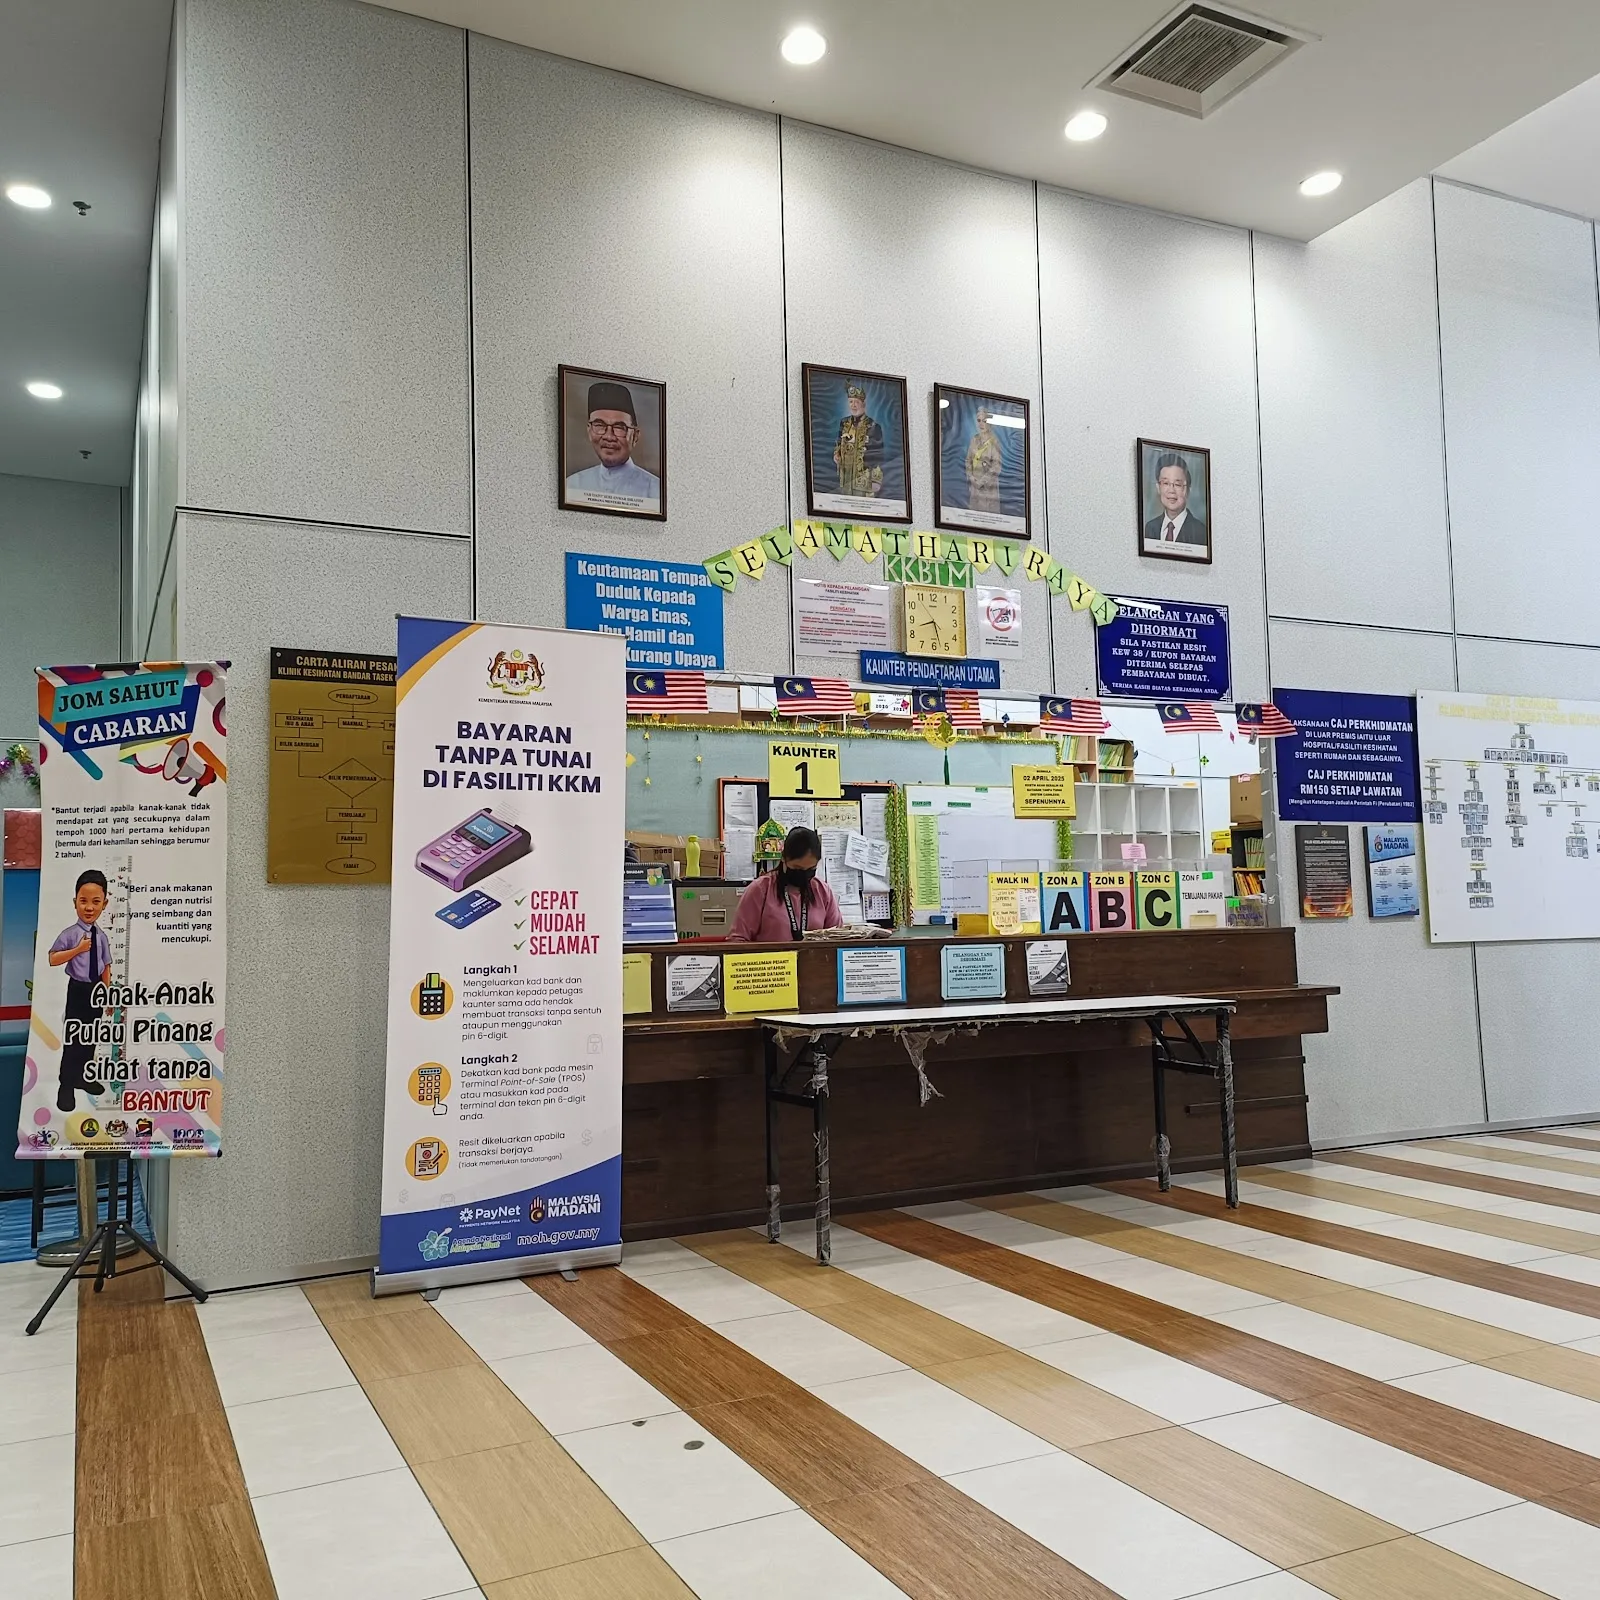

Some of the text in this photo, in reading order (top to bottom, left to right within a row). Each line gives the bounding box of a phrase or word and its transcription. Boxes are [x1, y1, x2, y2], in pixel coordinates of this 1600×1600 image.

[577, 560, 659, 582] Keutamaan
[714, 522, 1108, 623] SELAMAT HARI RAYA
[596, 582, 696, 605] Duduk Kepada
[601, 603, 691, 627] Warga Emas,
[1119, 606, 1215, 624] ELANGGAN YANG
[625, 626, 665, 643] Hamil
[668, 629, 695, 646] dan
[1131, 623, 1197, 638] DIHORMATI
[1120, 638, 1207, 652] SILA PASTIKAN RESIT
[296, 655, 329, 667] CARTA
[331, 658, 367, 670] ALIRAN
[626, 647, 717, 668] Kurang Upaya
[1112, 648, 1217, 663] KEW 38 / KUPON BAYARAN
[866, 658, 995, 683] KAUNTER PENDAFTARAN UTAMA
[1126, 659, 1204, 671] DITERIMA SELEPAS
[278, 667, 394, 683] KLINIK KESIHATAN BANDAR TASEK
[1121, 668, 1210, 682] PEMBAYARAN DIBUAT.
[58, 679, 180, 713] JOM SAHUT
[73, 710, 187, 744] CABARAN
[1331, 717, 1413, 732] CAJ PERKHIDMATAN
[457, 721, 572, 744] BAYARAN
[1305, 730, 1391, 742] DI LUAR PREMIS IAITU LUAR
[772, 745, 837, 760] KAUNTER
[1303, 740, 1398, 752] HOSPITAL/FASILITI KESIHATAN
[435, 745, 592, 768] TANPA TUNAI
[1294, 751, 1323, 760] SEPERTI
[1323, 753, 1347, 761] RUMAH
[1361, 755, 1404, 763] SEBAGAINYA.
[423, 769, 601, 793] DI FASILITI KKM
[794, 761, 814, 795] 1
[1307, 769, 1393, 782] CAJ PERKHIDMATAN
[1300, 784, 1402, 797] RM150 SETIAP LAWATAN
[83, 806, 107, 814] terjadi
[110, 805, 135, 813] apabila
[139, 803, 187, 812] kanak-kanak
[56, 817, 94, 826] mendapat
[113, 816, 129, 824] yang
[134, 814, 181, 823] secukupnya
[56, 829, 85, 837] tempoh
[129, 826, 164, 835] pertama
[169, 825, 210, 834] kehidupan
[55, 839, 87, 848] (bermula
[103, 837, 139, 845] kehamilan
[141, 837, 175, 845] sehingga
[1384, 842, 1410, 850] MADANI
[61, 850, 86, 858] tahun).
[996, 876, 1029, 884] WALK IN
[1046, 876, 1078, 885] ZON A
[1094, 876, 1125, 885] ZON B
[1141, 874, 1170, 883] ZON C
[129, 883, 213, 893] Beri anak makanan
[150, 896, 212, 906] dengan nutrisi
[530, 890, 579, 910] CEPAT
[1181, 891, 1223, 901] TEMUJANJI PAKAR
[129, 909, 212, 919] yang seimbang dan
[1048, 891, 1082, 931] A
[1098, 890, 1127, 929] B
[1143, 888, 1172, 928] C
[156, 922, 212, 931] kuantiti yang
[530, 913, 586, 933] MUDAH
[161, 934, 212, 943] mencukupi.
[529, 935, 600, 955] SELAMAT
[463, 964, 517, 977] Langkah 1
[463, 976, 582, 989] Mengeluarkan kad bank dan
[91, 980, 215, 1006] Anak-Anak
[64, 1019, 213, 1044] Pulau Pinang
[461, 1031, 508, 1042] pin 6-digit.
[461, 1053, 518, 1067] Langkah 2
[85, 1057, 211, 1081] sihat tanpa
[123, 1090, 211, 1111] BANTUT
[547, 1193, 601, 1207] MALAYSIA
[475, 1204, 521, 1221] PayNet
[547, 1202, 601, 1218] MADANI
[516, 1226, 601, 1246] moh.gov.my
